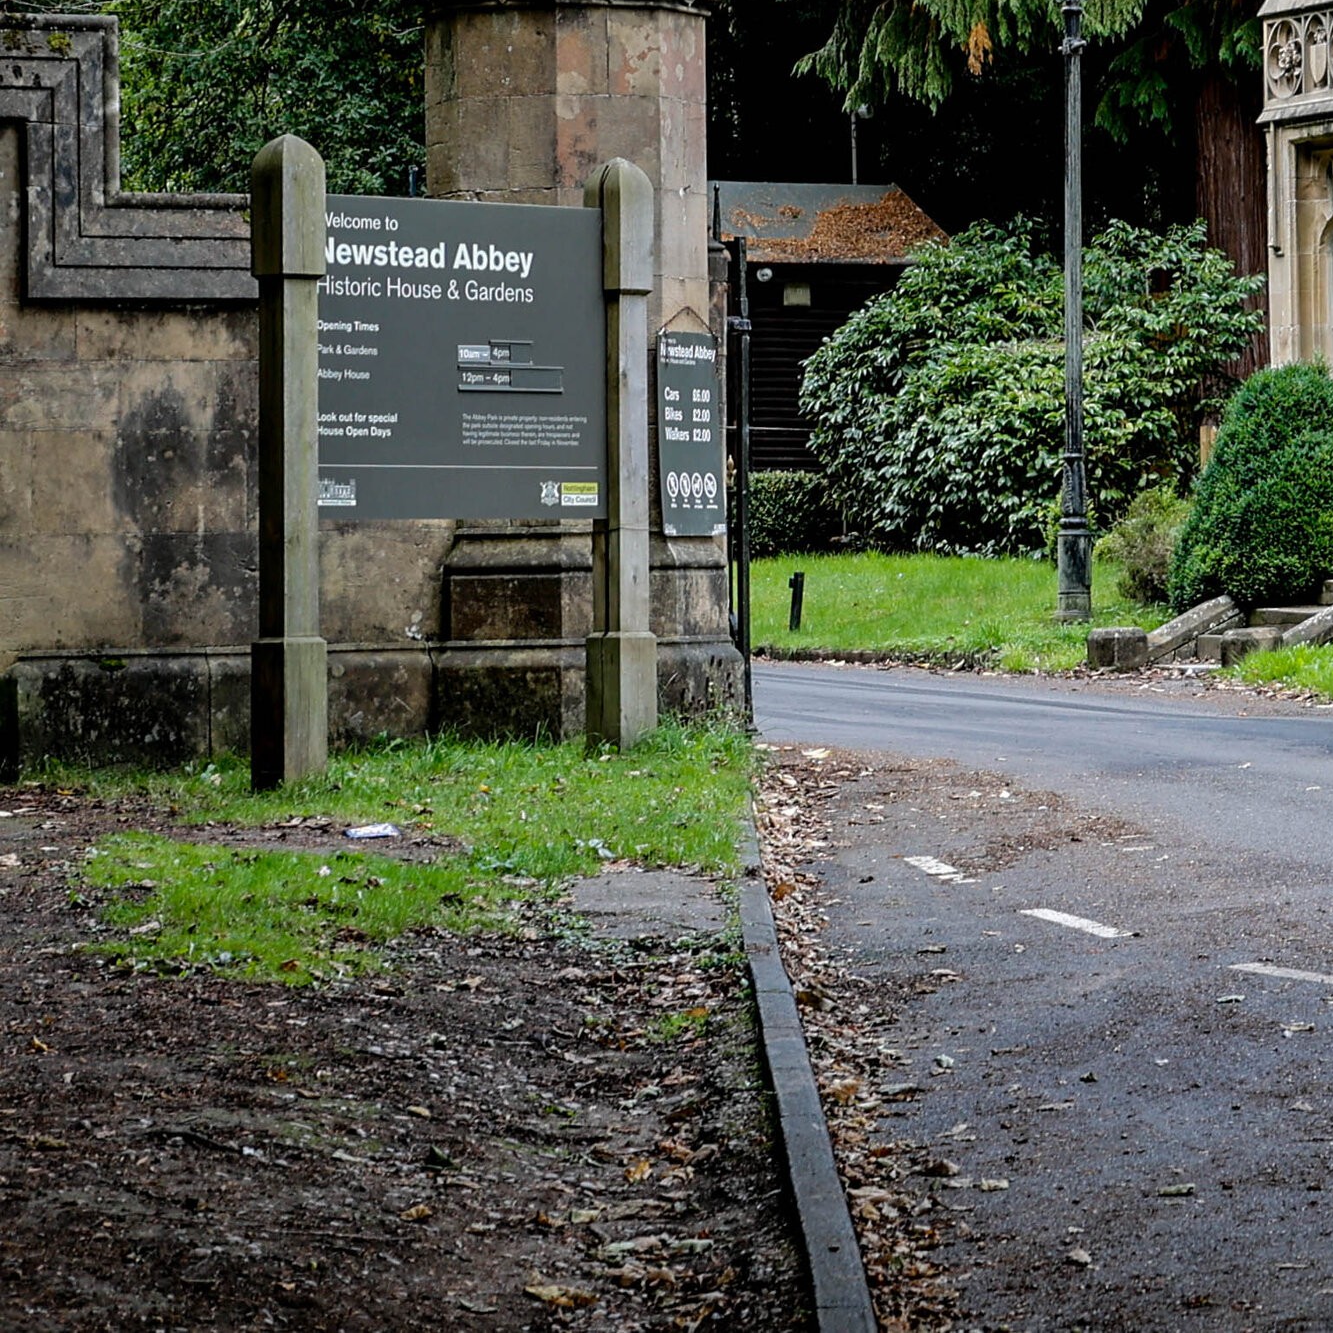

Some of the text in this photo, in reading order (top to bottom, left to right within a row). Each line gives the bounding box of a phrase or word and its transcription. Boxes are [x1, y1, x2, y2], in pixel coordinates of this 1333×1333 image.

[385, 216, 399, 231] to
[453, 243, 534, 278] Abbey
[317, 275, 534, 303] Historic House & Gardens
[317, 320, 379, 332] Opening Times
[317, 344, 378, 356] Park & Gardens
[459, 348, 480, 359] 10am
[492, 347, 510, 358] 4pm
[694, 344, 716, 363] Abbey
[317, 368, 370, 381] Abbey House
[462, 372, 484, 384] 12pm
[492, 373, 510, 385] 4pm
[664, 386, 680, 401] Cars
[317, 412, 398, 424] Look out for special
[665, 406, 711, 423] Bikes £2.00
[317, 426, 391, 438] House Open Days
[665, 426, 711, 443] Walkers £2.00
